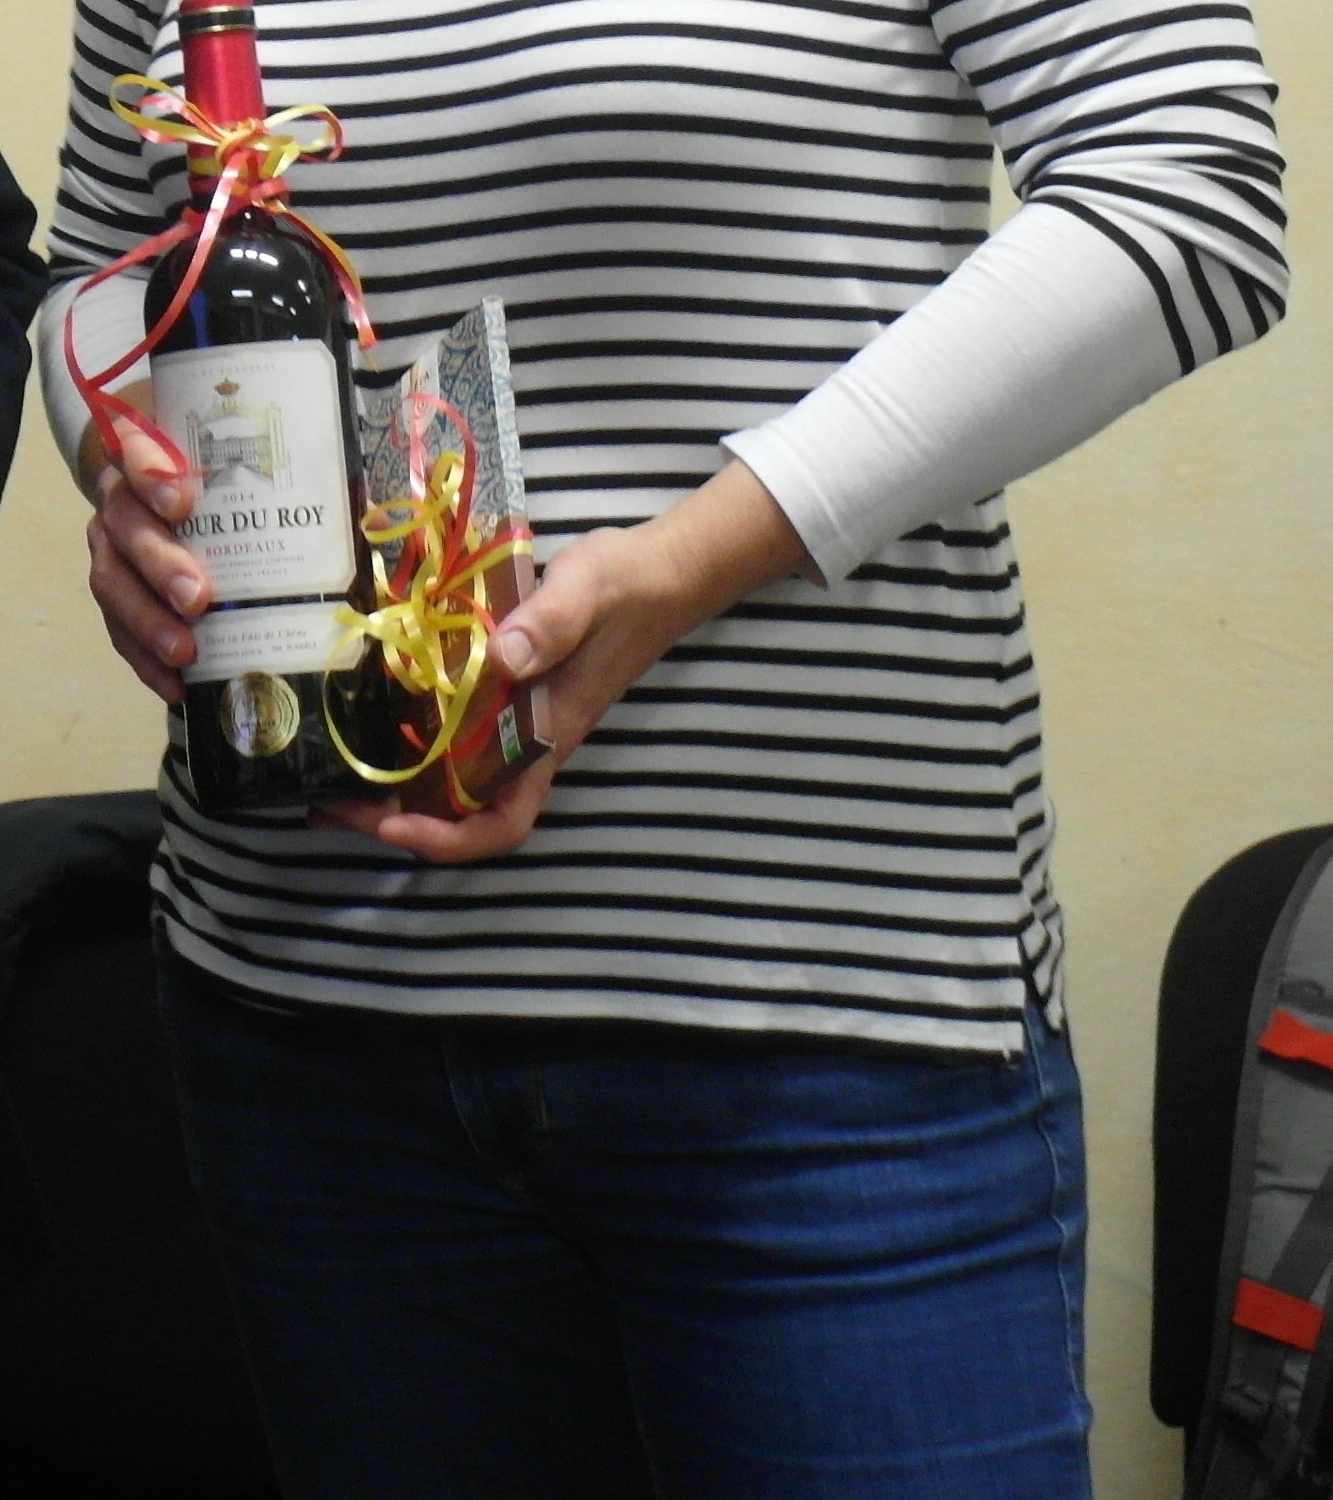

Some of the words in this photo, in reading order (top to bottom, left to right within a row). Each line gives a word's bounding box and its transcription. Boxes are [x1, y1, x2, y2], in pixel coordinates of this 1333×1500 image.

[231, 508, 268, 533] DU
[277, 504, 325, 529] ROY
[205, 540, 286, 558] BORDEAUX
